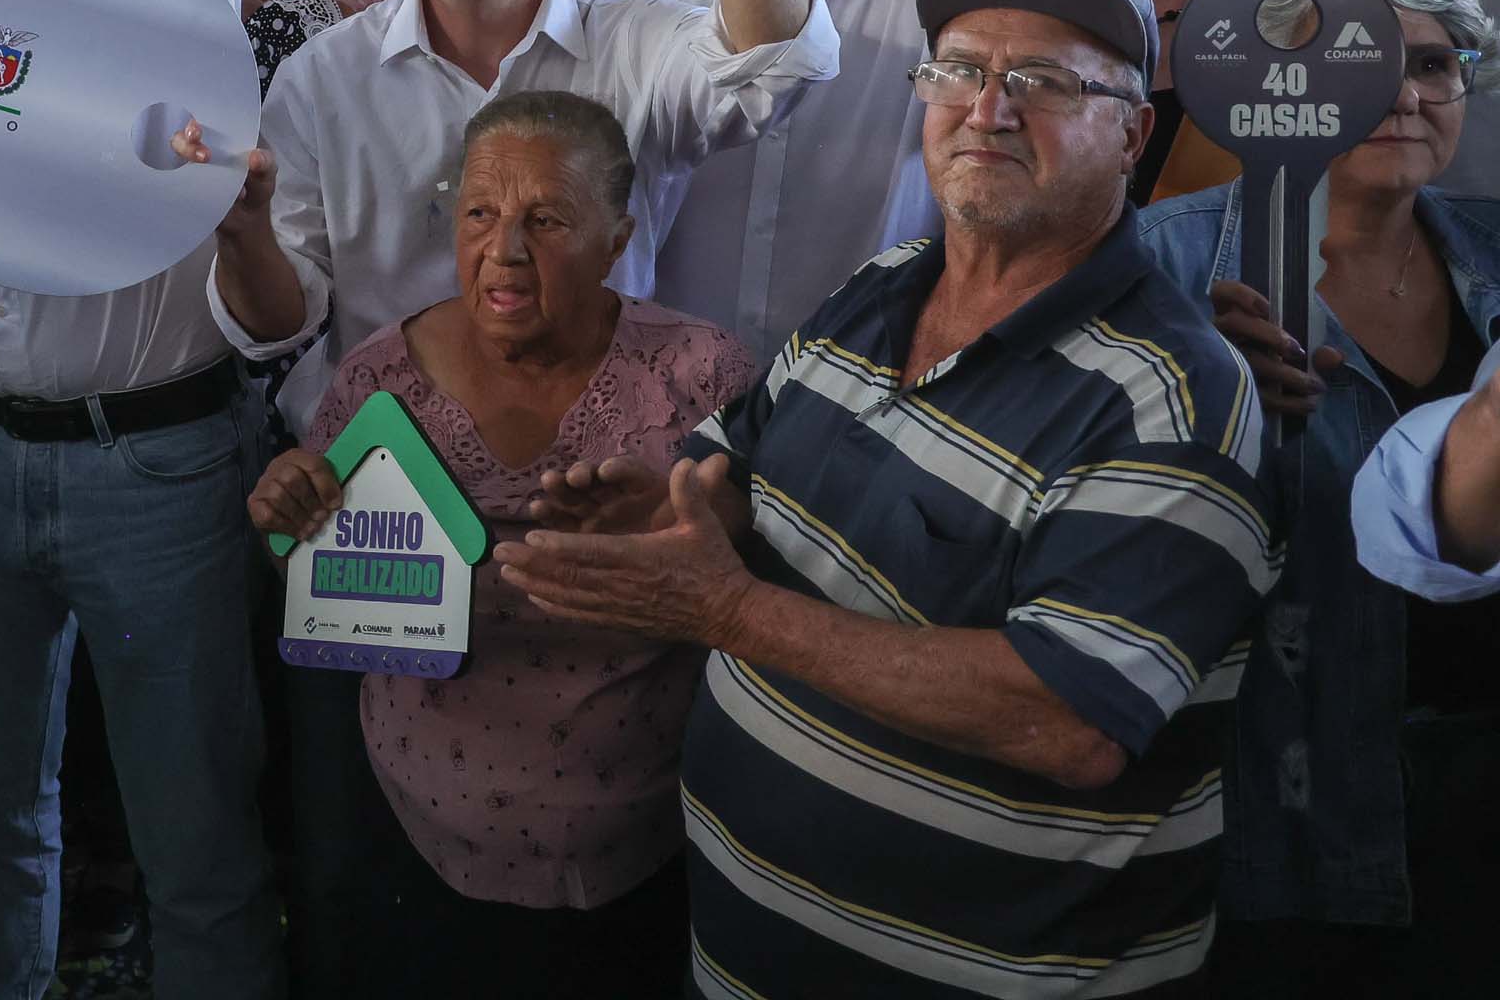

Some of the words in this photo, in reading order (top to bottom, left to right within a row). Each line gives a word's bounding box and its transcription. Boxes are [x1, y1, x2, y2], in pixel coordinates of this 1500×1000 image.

[1324, 50, 1382, 60] COHAPAR
[1262, 62, 1308, 97] 40
[1229, 103, 1340, 138] CASAS
[335, 509, 424, 551] SONHO
[315, 556, 441, 598] REALIZADO
